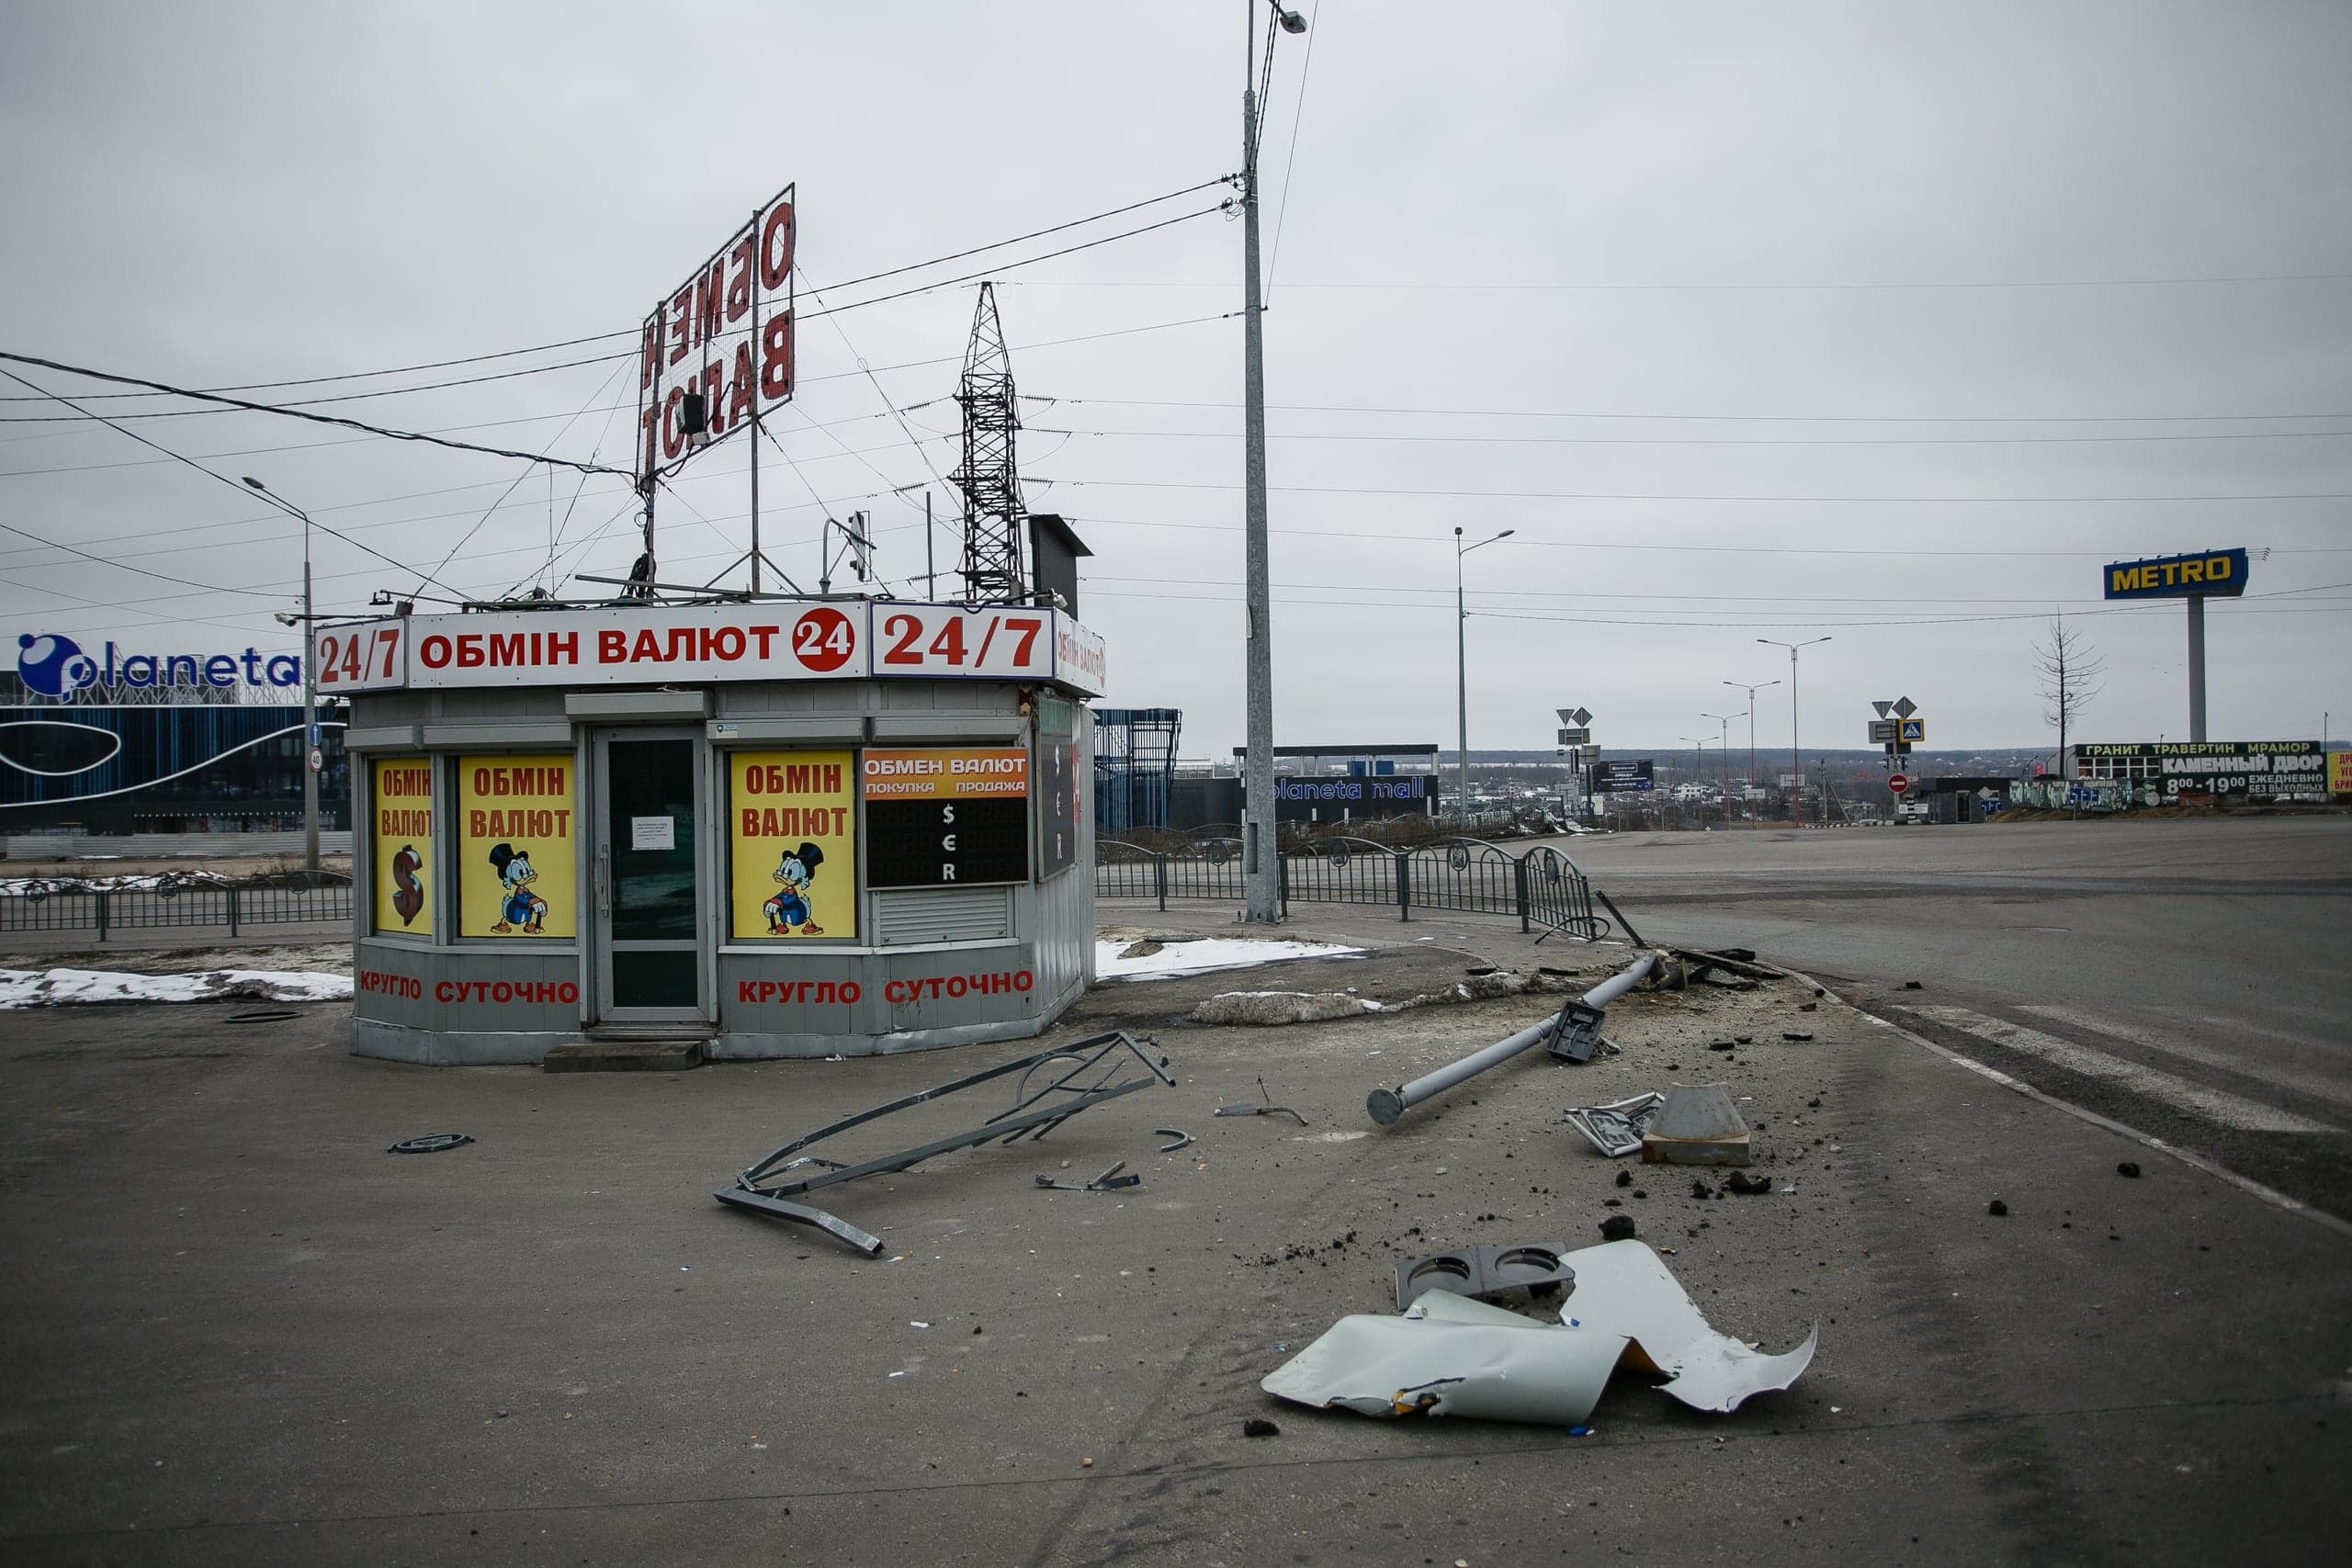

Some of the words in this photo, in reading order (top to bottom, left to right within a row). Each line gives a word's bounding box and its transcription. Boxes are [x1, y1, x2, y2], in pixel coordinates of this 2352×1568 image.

[2113, 556, 2232, 592] METRO
[320, 628, 401, 683] 24/7
[419, 630, 580, 670] ОБМІН
[597, 626, 780, 665] ВАЛЮТ
[796, 620, 852, 657] 24
[883, 614, 1042, 669] 24/7
[61, 641, 301, 705] planeta
[2086, 745, 2142, 755] ГРАНИТ
[2153, 744, 2235, 755] ТРАВЕРТИН
[2247, 742, 2311, 753] МРАМОР
[2162, 753, 2269, 773] КАМЕННЫЙ
[2273, 755, 2324, 773] ДВОР
[745, 764, 842, 795] ОБМІН
[865, 760, 944, 775] ОБМЕН
[950, 758, 1027, 774] ВАЛЮТ
[2248, 773, 2324, 784] ЕЖЕДНЕВНО
[382, 768, 432, 797] ОБМІН
[473, 767, 566, 796] ОБМІН
[865, 783, 935, 794] ПОКУПКА
[956, 782, 1025, 793] ПРОДАЖА
[1372, 777, 1424, 798] mall
[2248, 784, 2267, 793] БЕЗ
[2268, 783, 2324, 793] ВЫХОДНЫХ
[469, 809, 571, 839] ВАЛЮТ
[741, 807, 848, 837] ВАЛЮТ
[943, 863, 956, 881] R
[360, 970, 423, 1000] КРУГЛО
[435, 981, 580, 1004] СУТОЧНО
[739, 980, 862, 1004] КРУГЛО
[884, 970, 1034, 1004] СУТОЧНО
